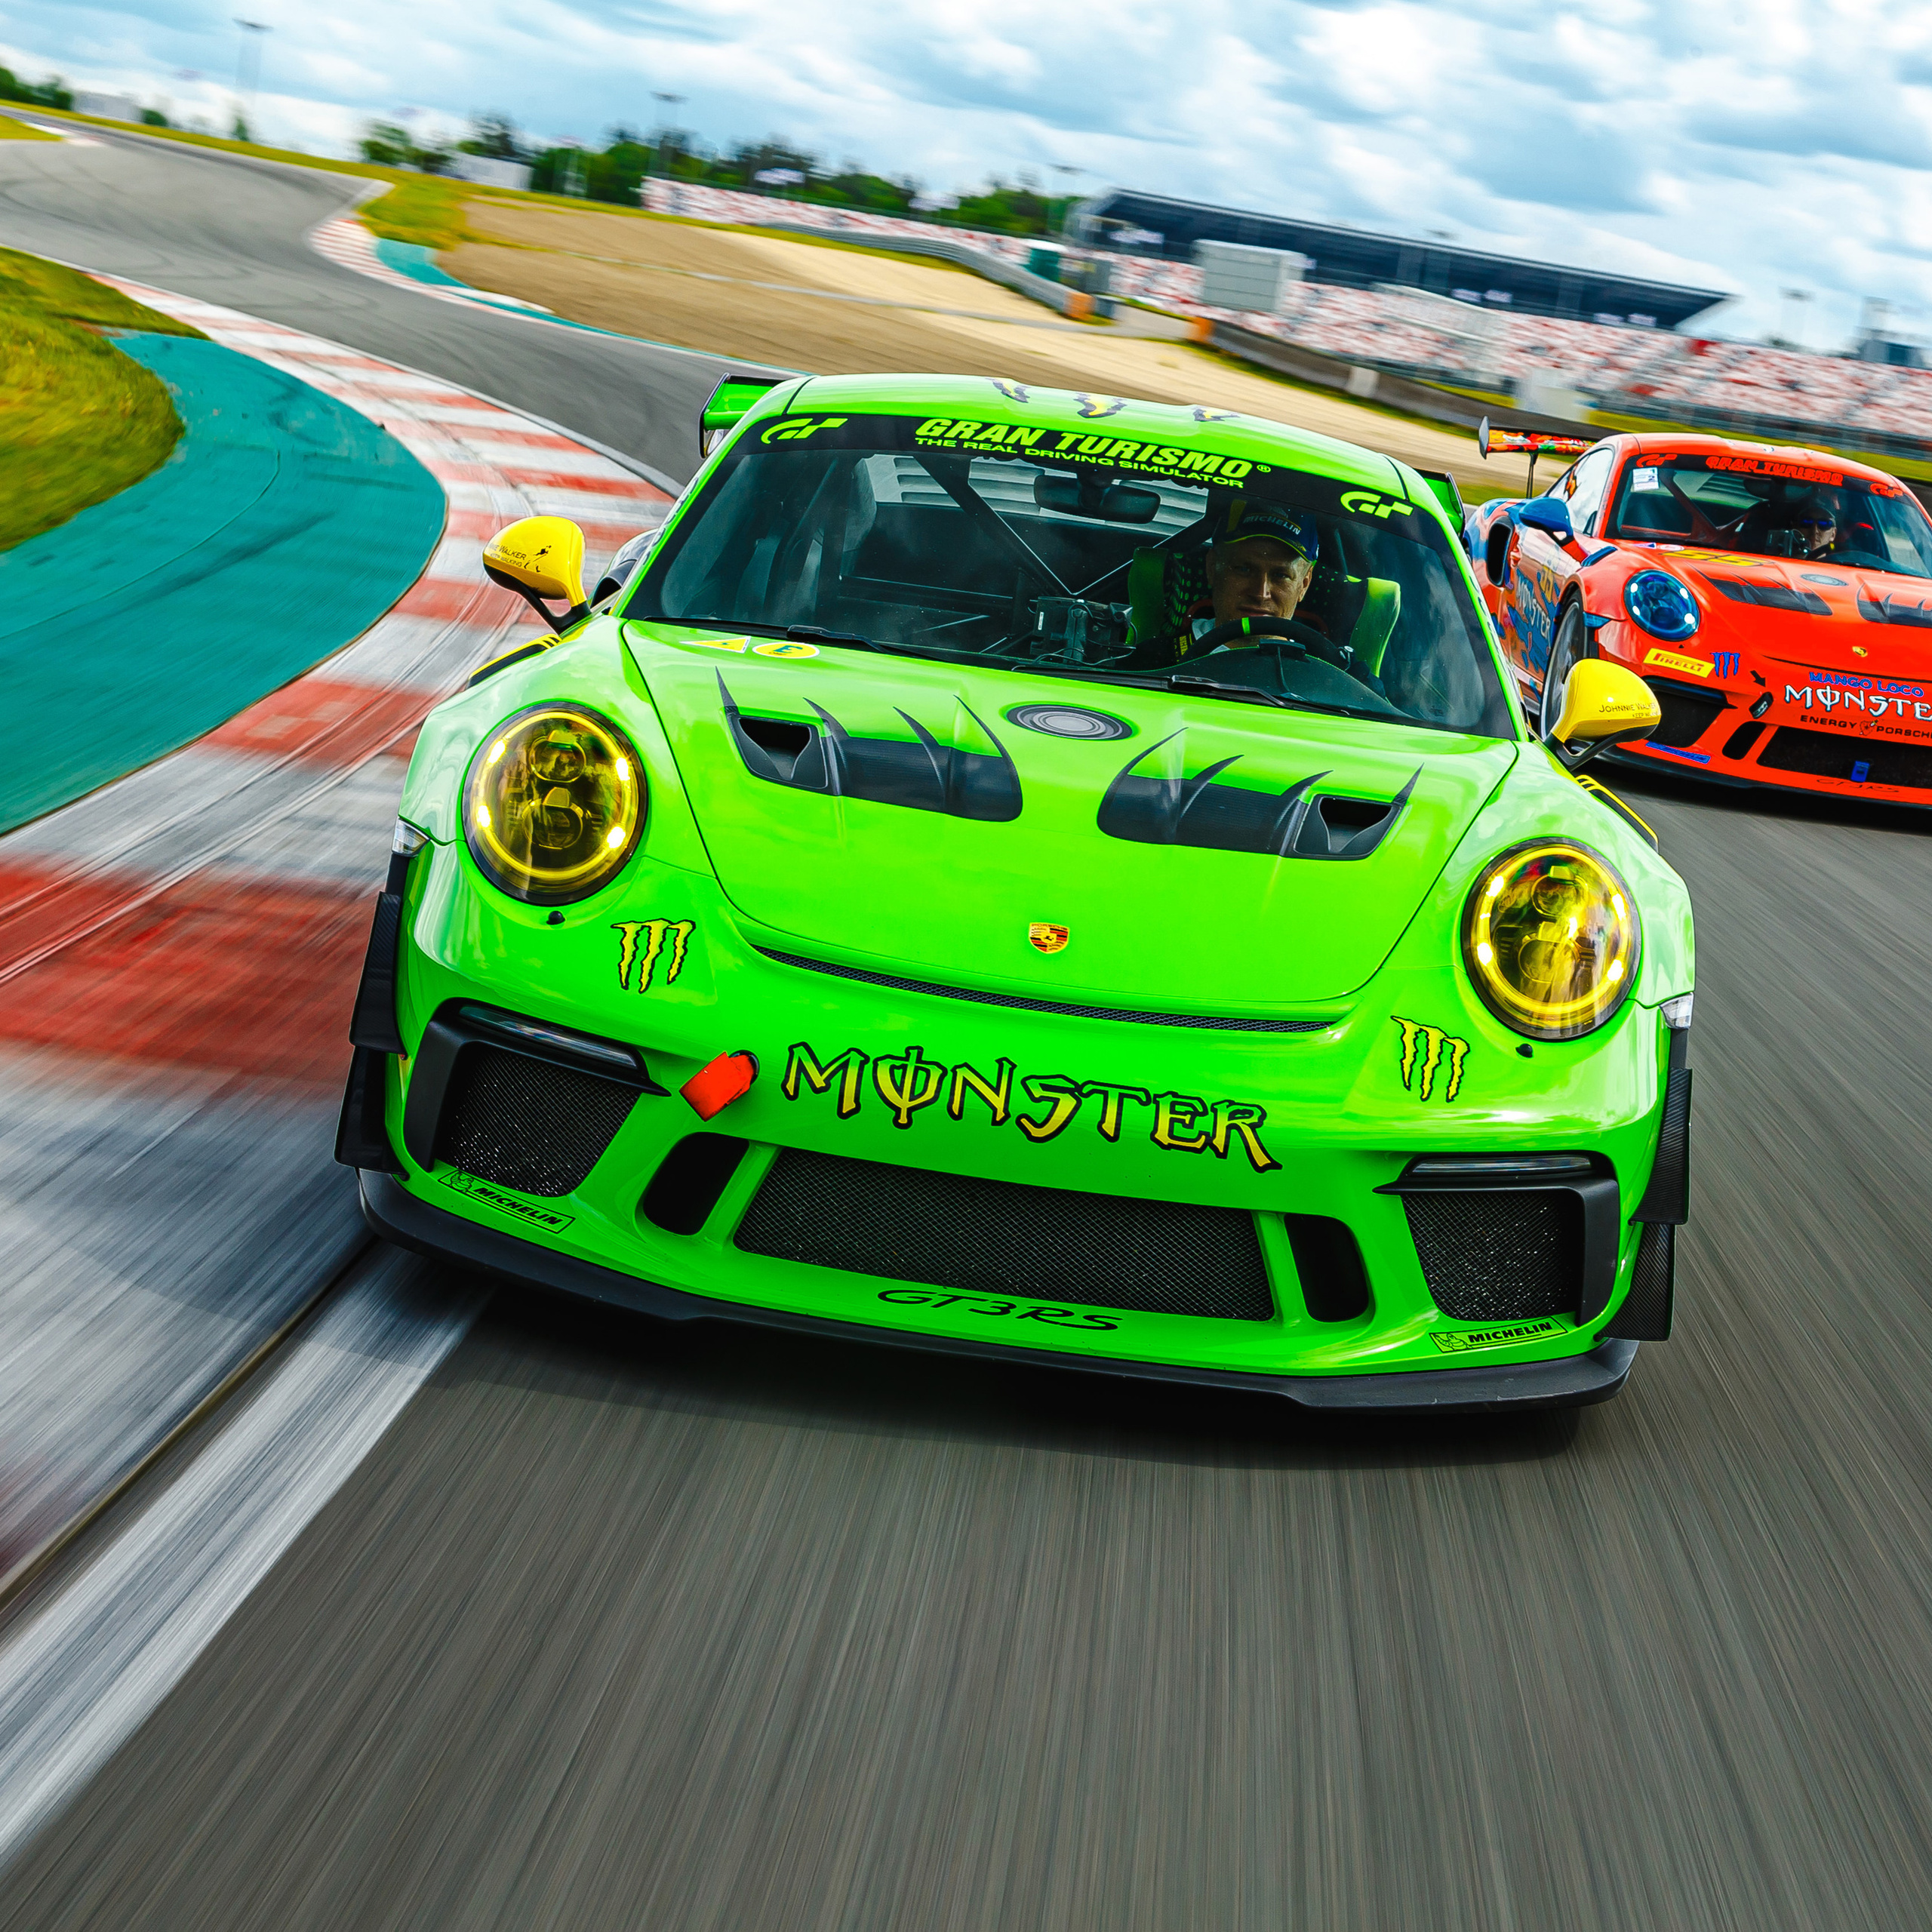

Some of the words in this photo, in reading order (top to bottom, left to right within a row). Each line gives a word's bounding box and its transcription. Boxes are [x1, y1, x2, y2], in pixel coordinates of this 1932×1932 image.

[915, 418, 1047, 446] GRAN
[1055, 432, 1253, 478] TURISMO
[915, 437, 957, 448] THE
[962, 441, 1018, 454] REAL
[1024, 448, 1114, 466] DRIVING
[1118, 460, 1244, 488] SIMULATOR
[1243, 515, 1301, 535] MICHELIN
[499, 545, 527, 561] WALKER
[1661, 549, 1770, 567] 55
[1653, 653, 1704, 672] PIRELLI
[1809, 671, 1873, 690] MANGO
[1877, 680, 1924, 697] LOCO
[1599, 704, 1635, 712] JOHNNIE
[1801, 715, 1857, 729] ENERGY
[781, 1041, 1282, 1172] MONSTER
[473, 1186, 564, 1226] MICHELIN
[1467, 1321, 1552, 1343] MICHELIN
